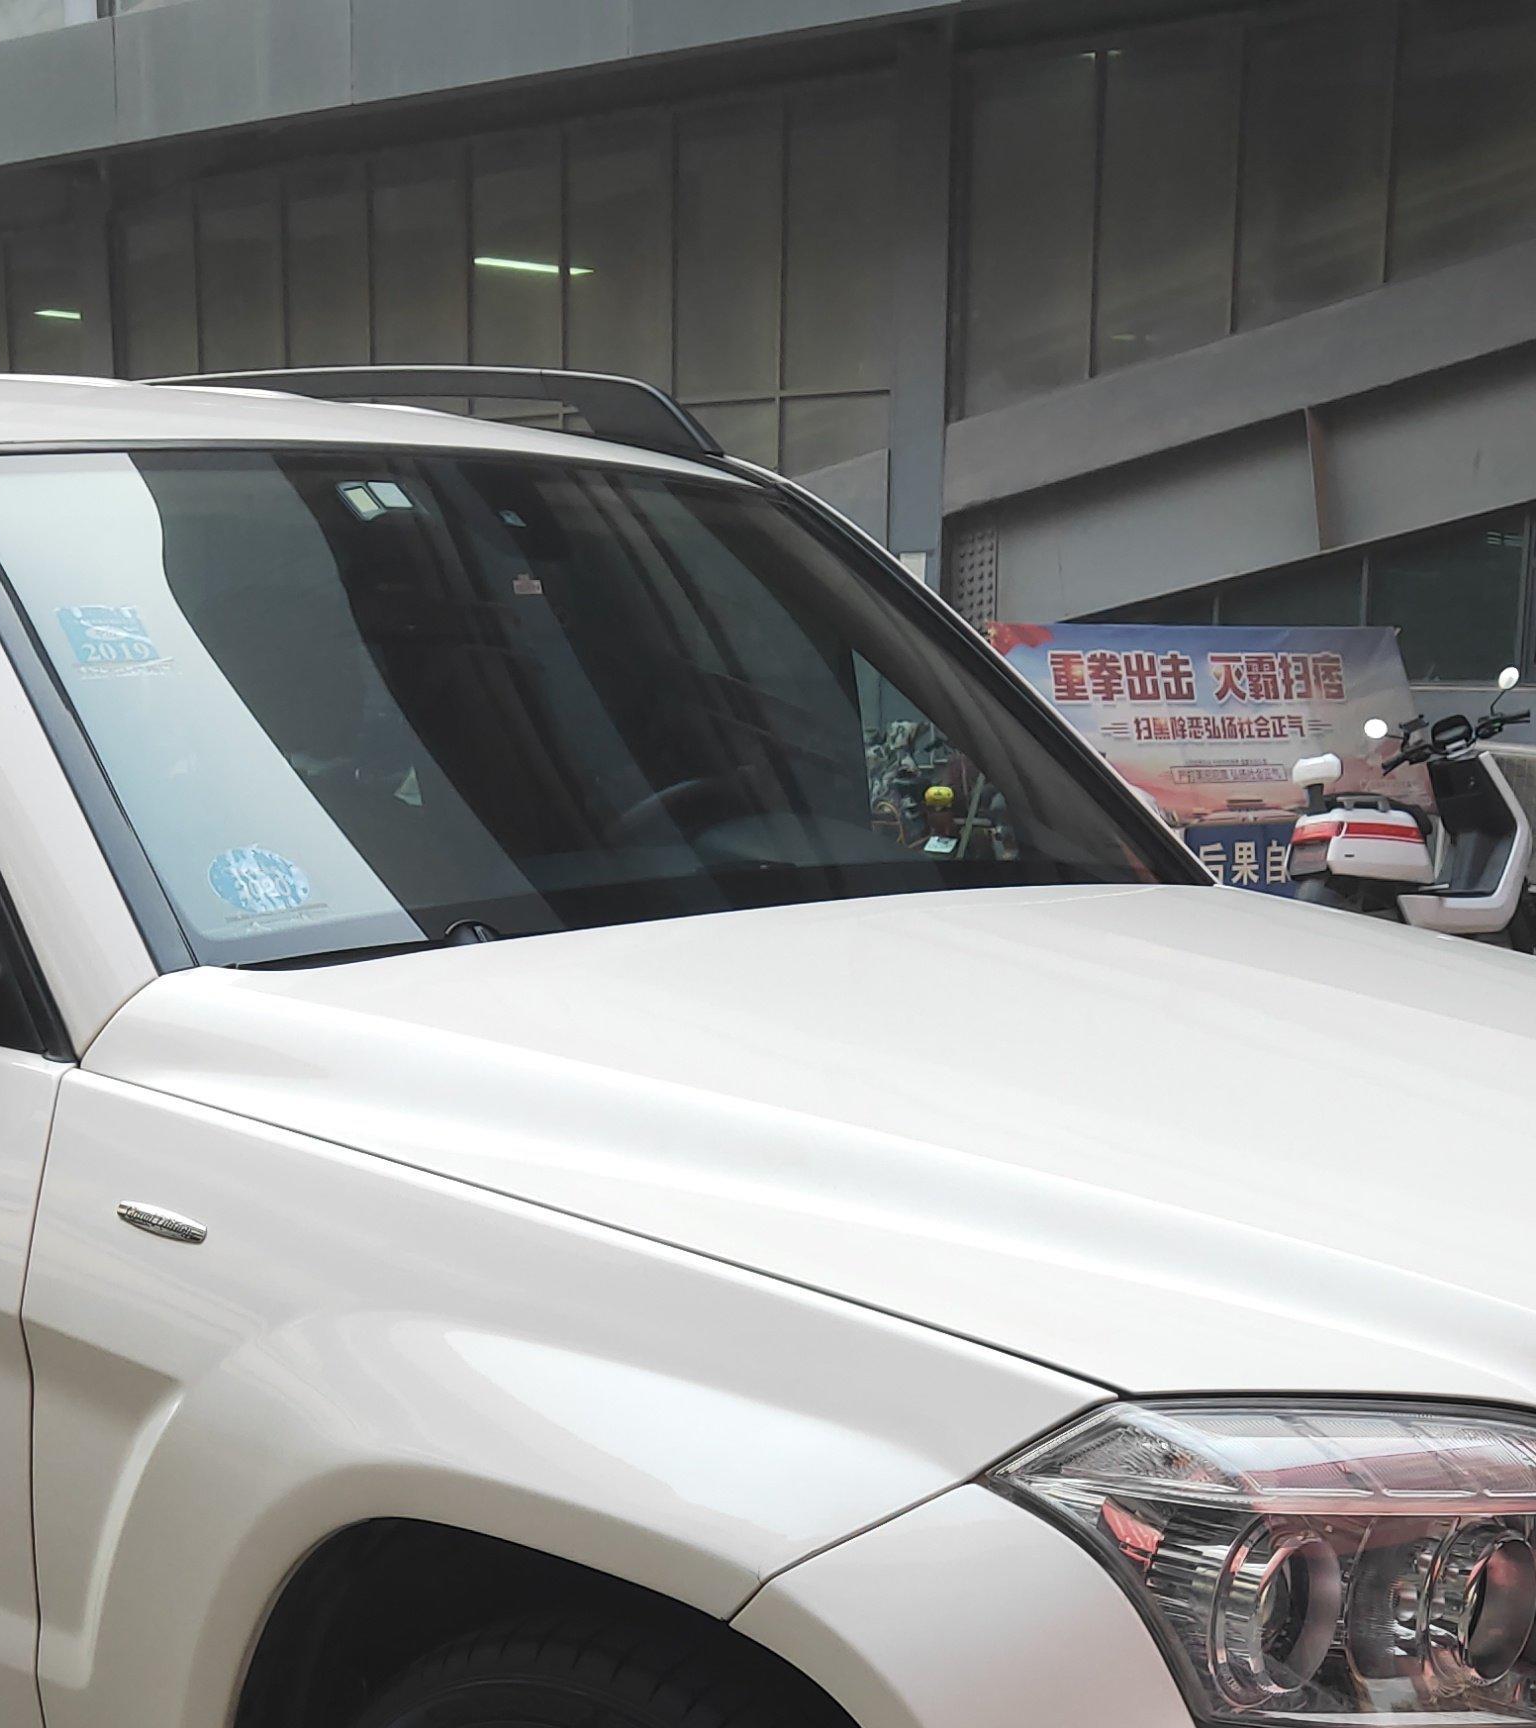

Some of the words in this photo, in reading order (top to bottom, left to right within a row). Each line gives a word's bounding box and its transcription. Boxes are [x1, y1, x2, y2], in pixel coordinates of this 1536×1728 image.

[1049, 651, 1196, 701] 重拳出击
[1209, 652, 1346, 702] 灭霸扫痞
[1134, 715, 1306, 740] 扫黑除恶弘扬社会正气
